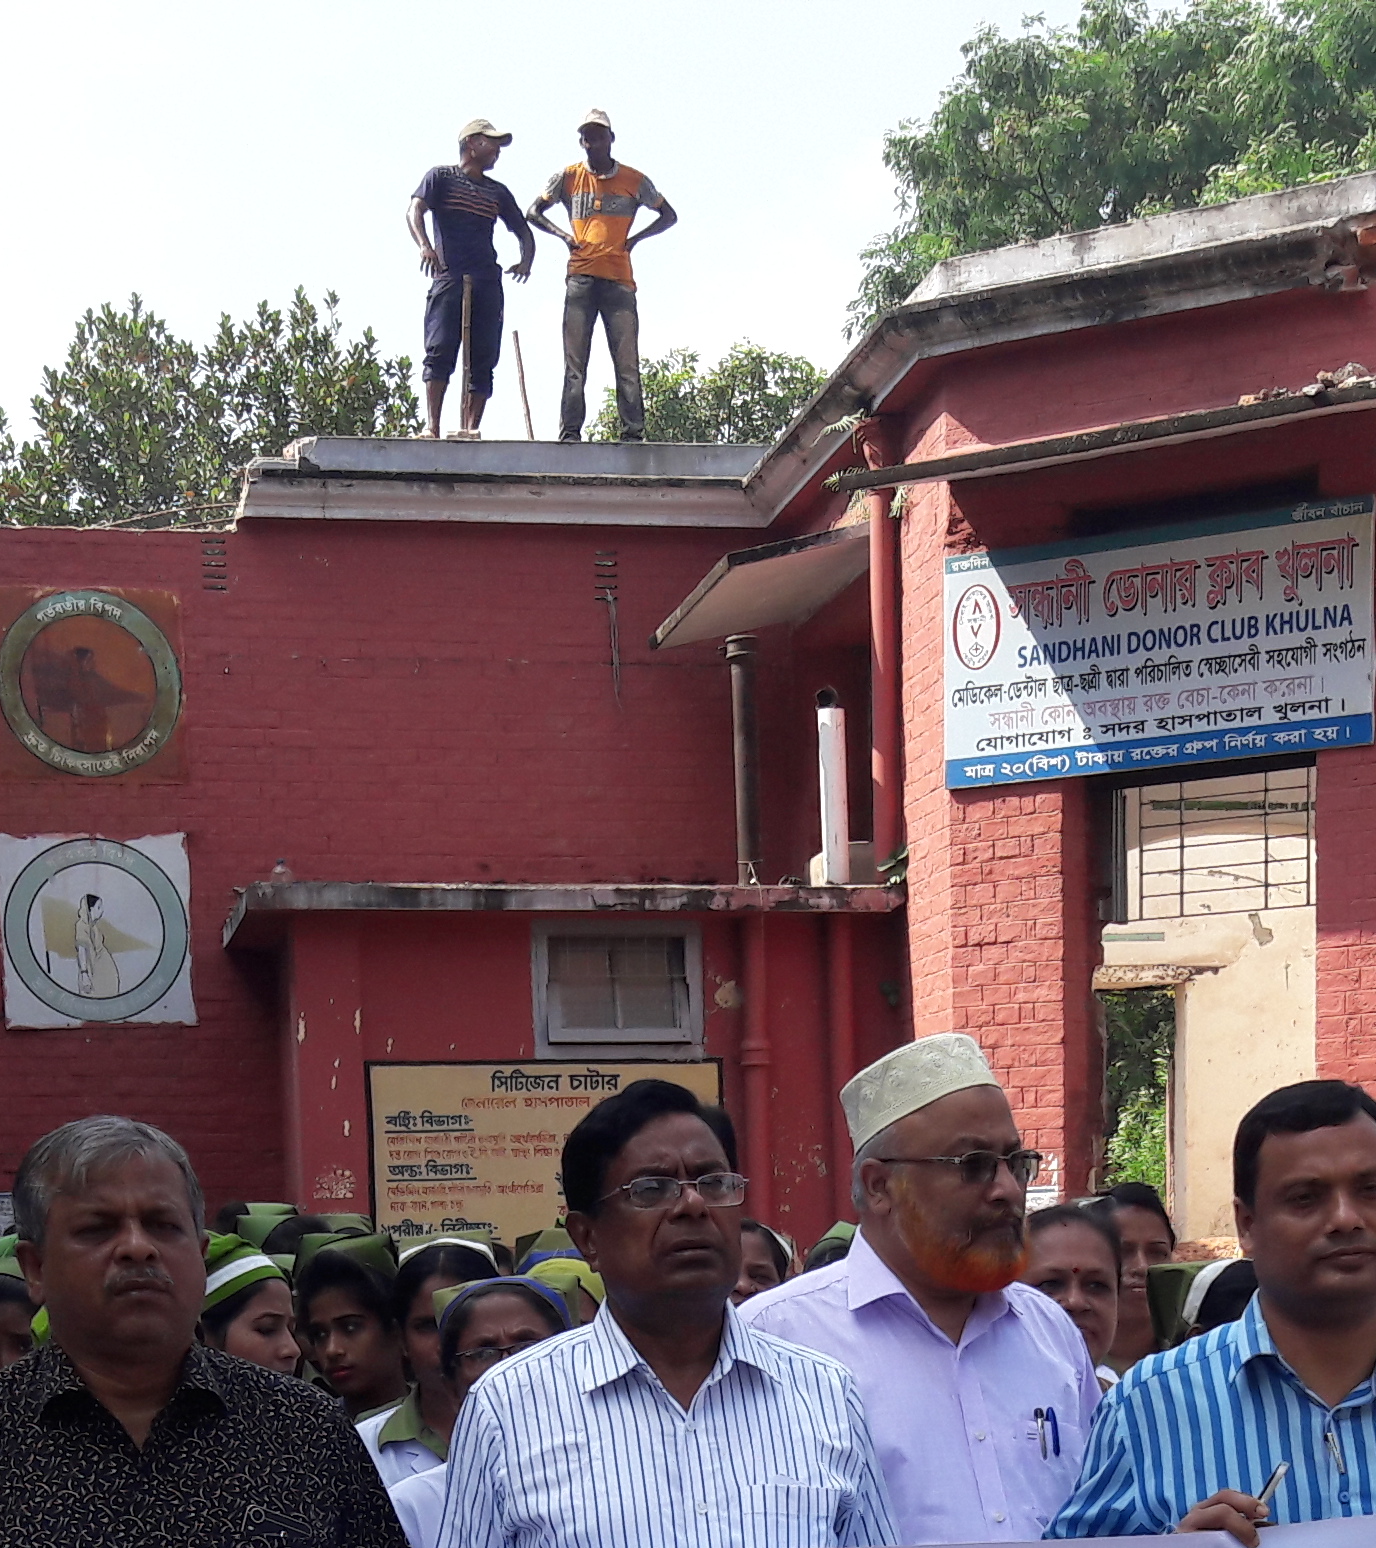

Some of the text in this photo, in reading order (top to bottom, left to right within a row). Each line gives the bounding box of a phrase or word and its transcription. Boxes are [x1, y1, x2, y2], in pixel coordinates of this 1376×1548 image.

[1007, 558, 1096, 631] সন্ধানী
[1103, 555, 1201, 616] ডোনার
[1204, 547, 1269, 610] ক্লাব
[1275, 531, 1359, 606] খুলনা
[1017, 634, 1121, 669] SANDHANI
[1127, 623, 1201, 655] DONOR
[1207, 615, 1259, 644] CLUB
[1265, 603, 1354, 637] KHULNA
[1135, 655, 1194, 686] পরিচালিত
[976, 727, 1074, 752] যোগাযোগ
[1099, 719, 1148, 738] সদর
[1153, 706, 1264, 732] হাসপাতাল
[1272, 697, 1333, 722] খুলনা
[1041, 703, 1077, 726] কোন
[1271, 729, 1307, 745] করা
[490, 1068, 562, 1093] সিটিজেন
